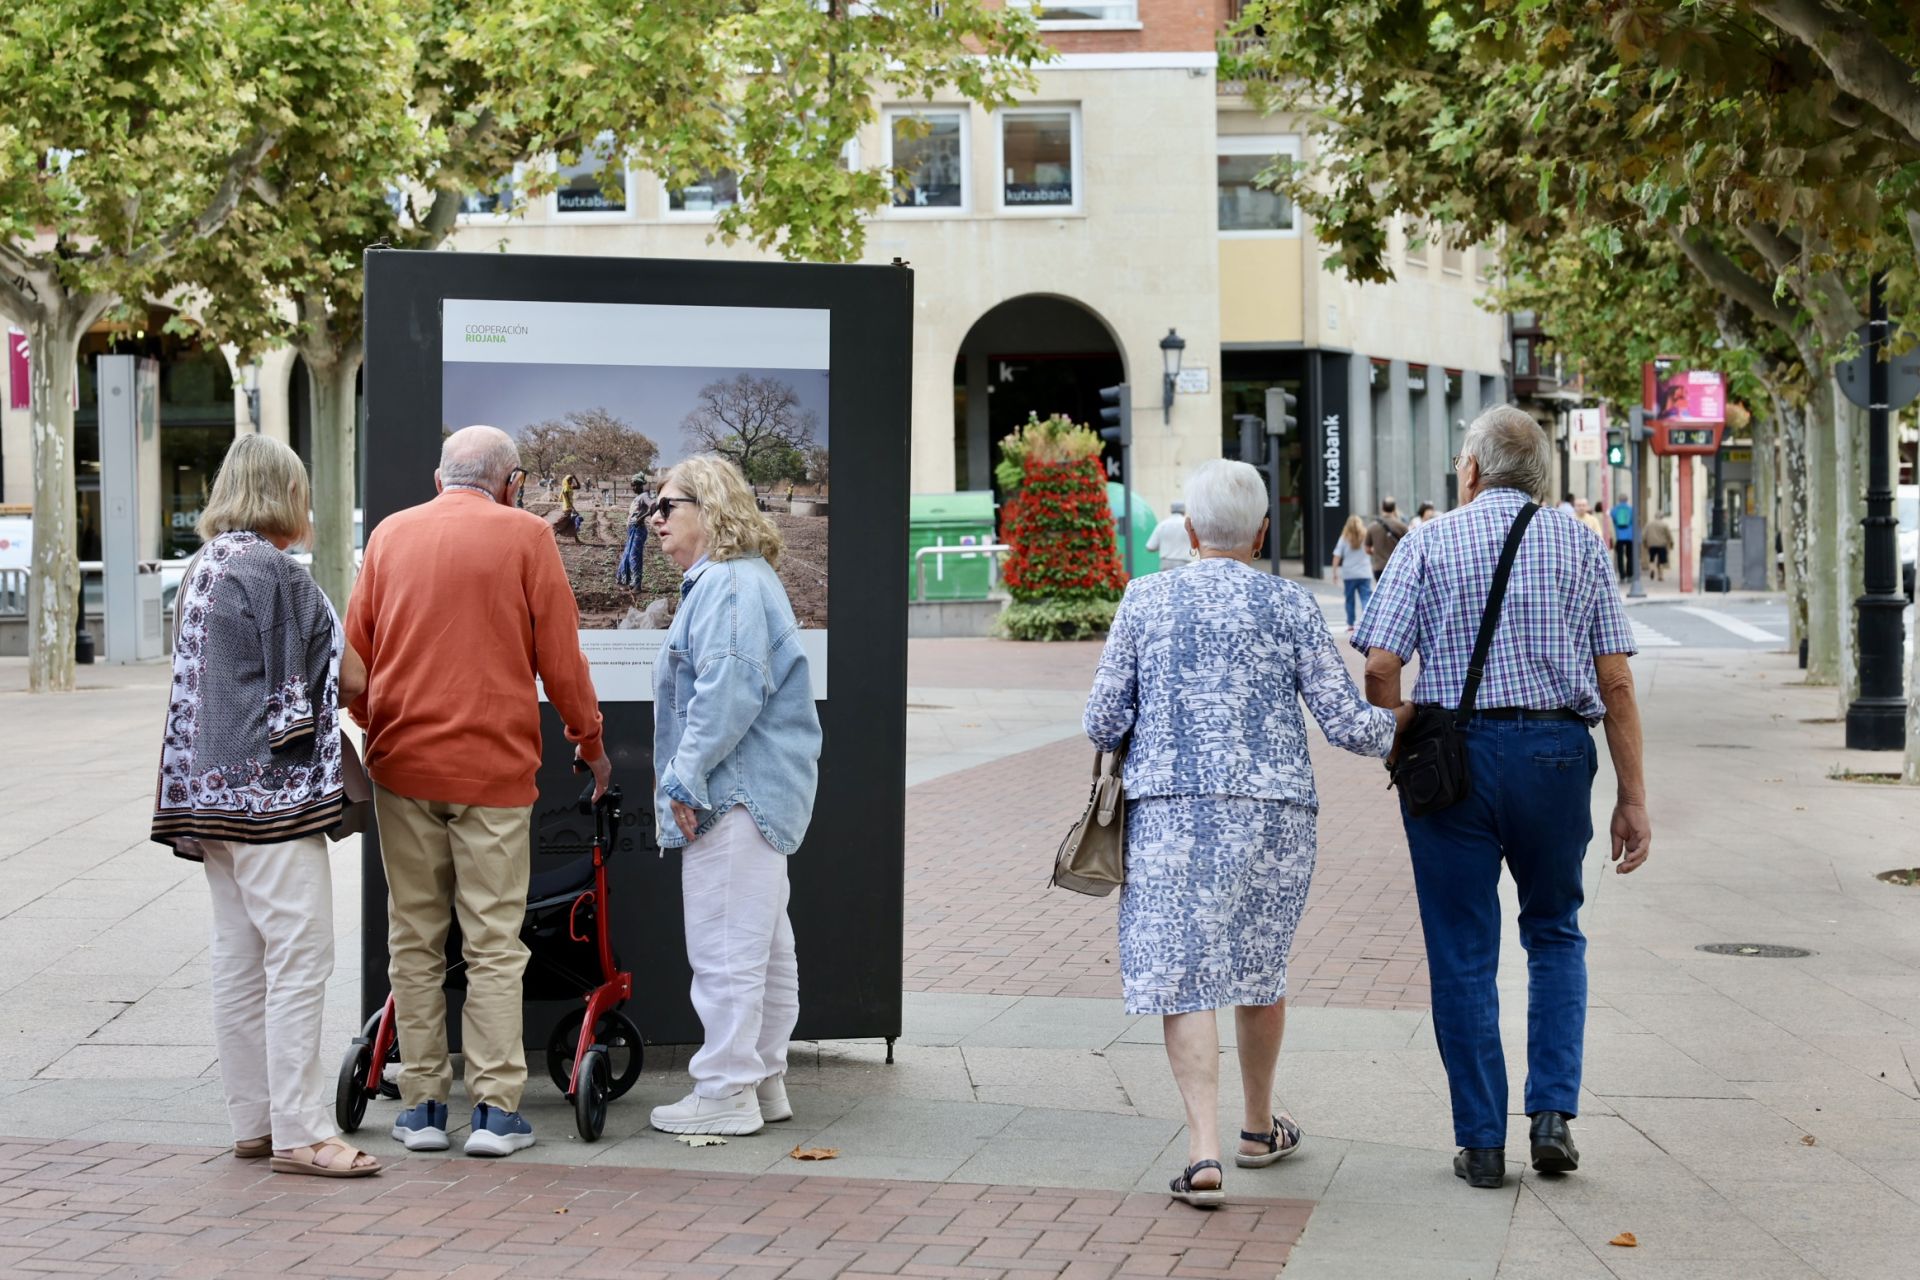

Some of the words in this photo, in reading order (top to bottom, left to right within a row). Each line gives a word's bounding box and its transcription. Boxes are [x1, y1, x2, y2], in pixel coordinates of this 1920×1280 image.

[465, 323, 529, 335] COOPERACIÓN
[465, 334, 507, 343] RIOJANA
[1322, 414, 1340, 507] kutxabank
